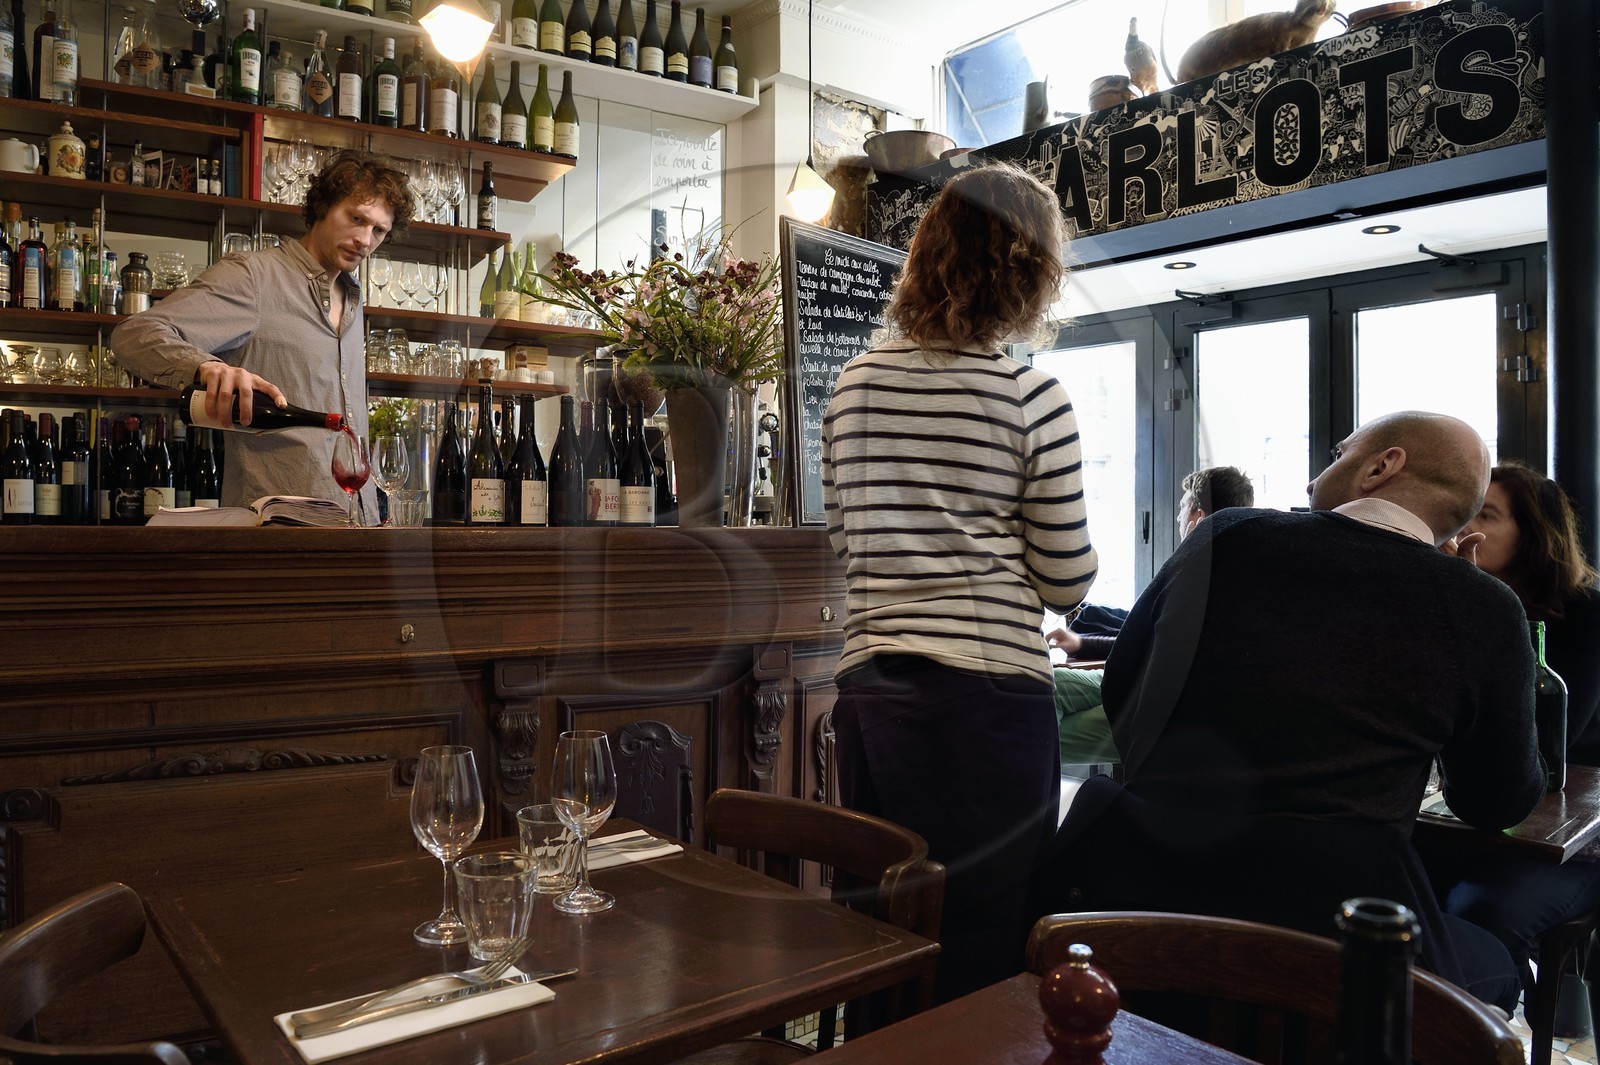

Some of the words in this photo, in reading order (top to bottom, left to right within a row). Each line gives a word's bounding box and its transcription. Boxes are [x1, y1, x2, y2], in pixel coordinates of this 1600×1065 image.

[1325, 30, 1373, 52] THOMAS
[1215, 66, 1268, 97] LES
[1053, 24, 1522, 233] ARLOTS
[799, 299, 823, 317] Salade
[823, 306, 832, 318] de
[803, 330, 826, 344] Salade
[826, 331, 835, 344] de
[823, 345, 832, 357] de
